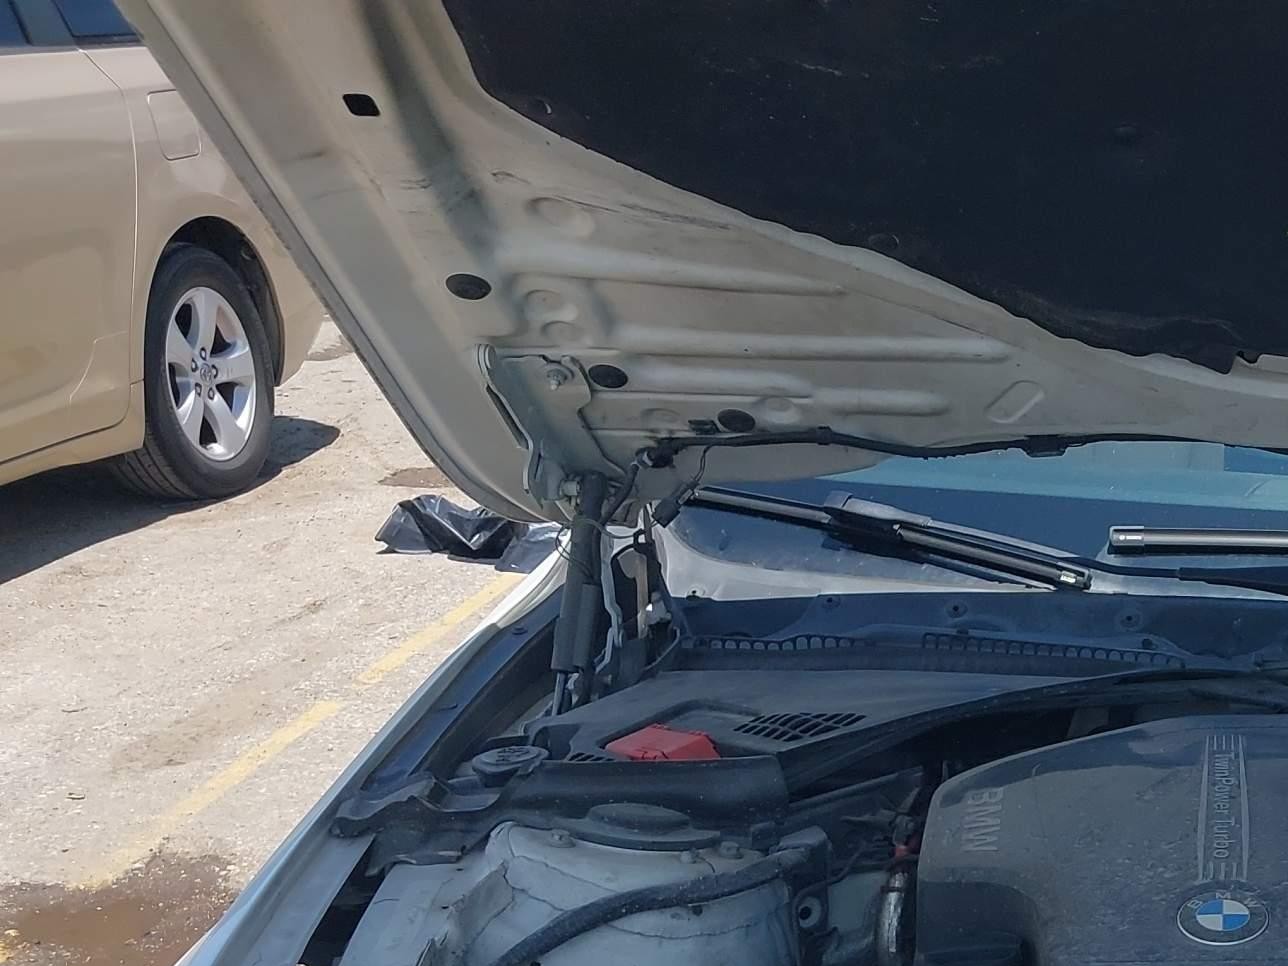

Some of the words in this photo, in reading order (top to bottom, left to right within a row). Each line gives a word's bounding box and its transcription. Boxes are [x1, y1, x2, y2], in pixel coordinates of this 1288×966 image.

[1214, 752, 1235, 814] TwinPower
[964, 788, 1003, 852] BMW
[1213, 817, 1235, 858] Turbo
[1186, 891, 1262, 909] BMW
